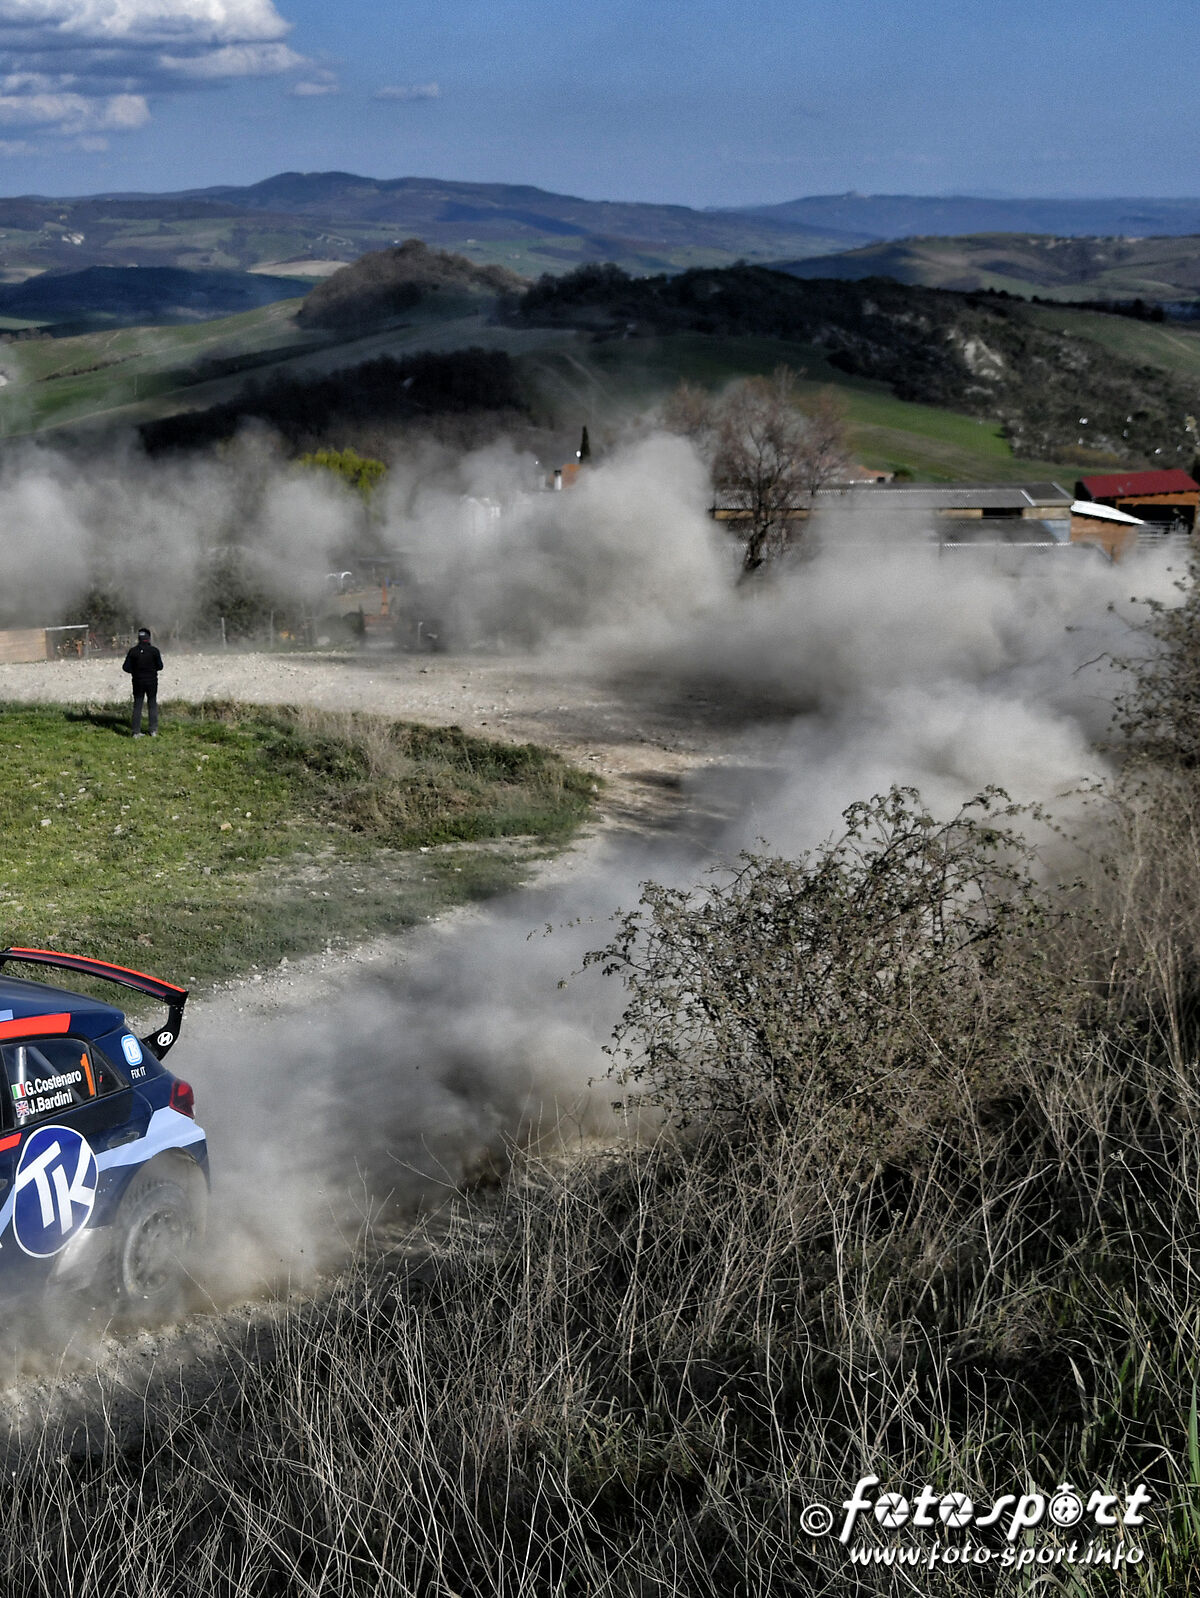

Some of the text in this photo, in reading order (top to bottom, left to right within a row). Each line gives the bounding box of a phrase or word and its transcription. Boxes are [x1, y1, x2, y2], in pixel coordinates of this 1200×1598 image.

[24, 1070, 82, 1096] G.Costenaro
[80, 1052, 96, 1097] 1
[29, 1088, 73, 1115] J.Bardini
